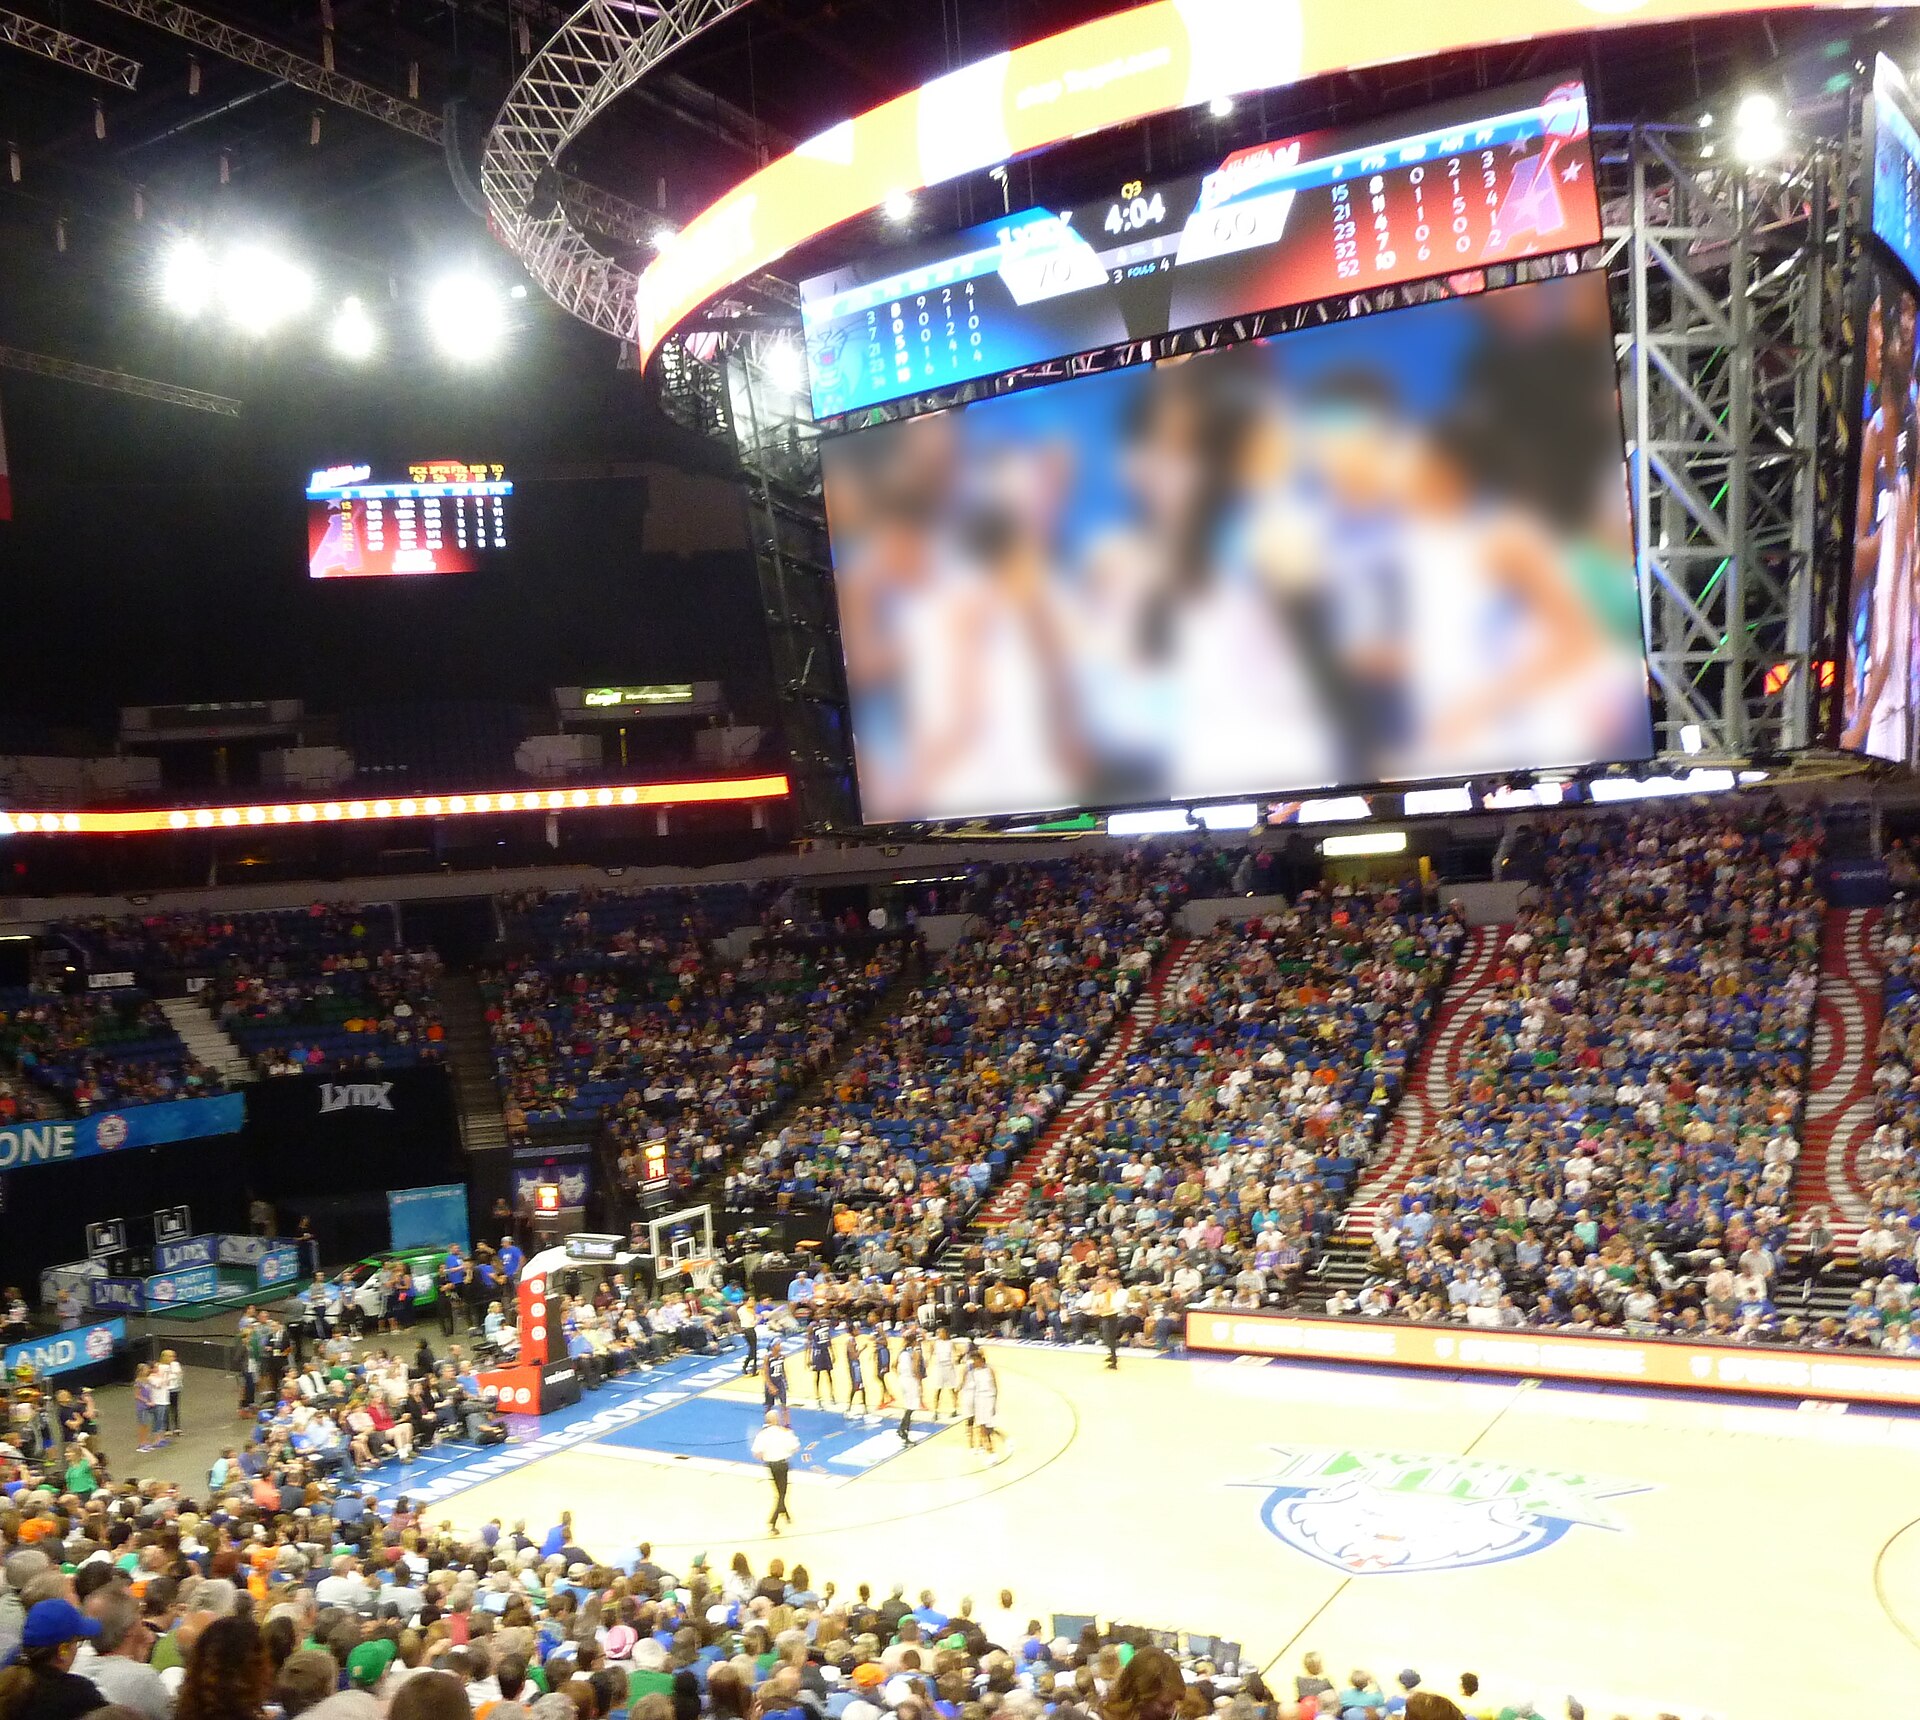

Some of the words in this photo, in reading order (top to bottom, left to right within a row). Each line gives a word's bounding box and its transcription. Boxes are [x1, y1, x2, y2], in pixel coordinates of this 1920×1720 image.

[1121, 180, 1143, 199] Q3
[1331, 183, 1349, 202] 15
[1409, 166, 1424, 184] 0
[1447, 158, 1461, 177] 2
[1481, 150, 1494, 169] 3
[1333, 203, 1351, 222] 21
[1371, 195, 1386, 214] 11
[1414, 186, 1422, 203] 1
[1452, 179, 1460, 195] 1
[1483, 170, 1496, 189] 3
[1104, 192, 1167, 235] 4:04
[1213, 210, 1258, 243] 60
[1333, 222, 1356, 242] 23
[1374, 214, 1389, 232] 4
[1416, 205, 1424, 222] 1
[1453, 197, 1466, 214] 5
[1485, 190, 1498, 208] 4
[1334, 241, 1357, 260] 32
[1376, 232, 1390, 251] 7
[1415, 225, 1430, 242] 0
[1453, 217, 1468, 233] 0
[1490, 209, 1497, 226] 1
[1113, 269, 1124, 284] 3
[1160, 257, 1170, 272] 4
[1337, 260, 1360, 279] 52
[1375, 251, 1396, 271] 10
[1417, 244, 1430, 261] 6
[1456, 235, 1470, 253] 0
[1489, 229, 1502, 247] 2
[867, 311, 876, 325] 3
[916, 296, 926, 310] 9
[942, 288, 952, 302] 2
[965, 282, 974, 295] 4
[868, 327, 877, 341] 7
[892, 319, 904, 334] 0
[918, 312, 929, 326] 0
[946, 306, 952, 319] 1
[968, 299, 974, 312] 1
[868, 342, 881, 358] 21
[895, 334, 906, 351] 5
[921, 329, 931, 343] 0
[946, 322, 955, 336] 2
[968, 315, 979, 329] 0
[925, 345, 930, 359] 1
[949, 339, 957, 352] 4
[970, 332, 981, 346] 0
[491, 464, 504, 473] TO
[495, 473, 502, 481] 7
[495, 527, 503, 537] 7
[175, 1271, 212, 1284] PARTY
[176, 1282, 215, 1300] ZONE
[411, 1390, 691, 1503] MINNESOTA
